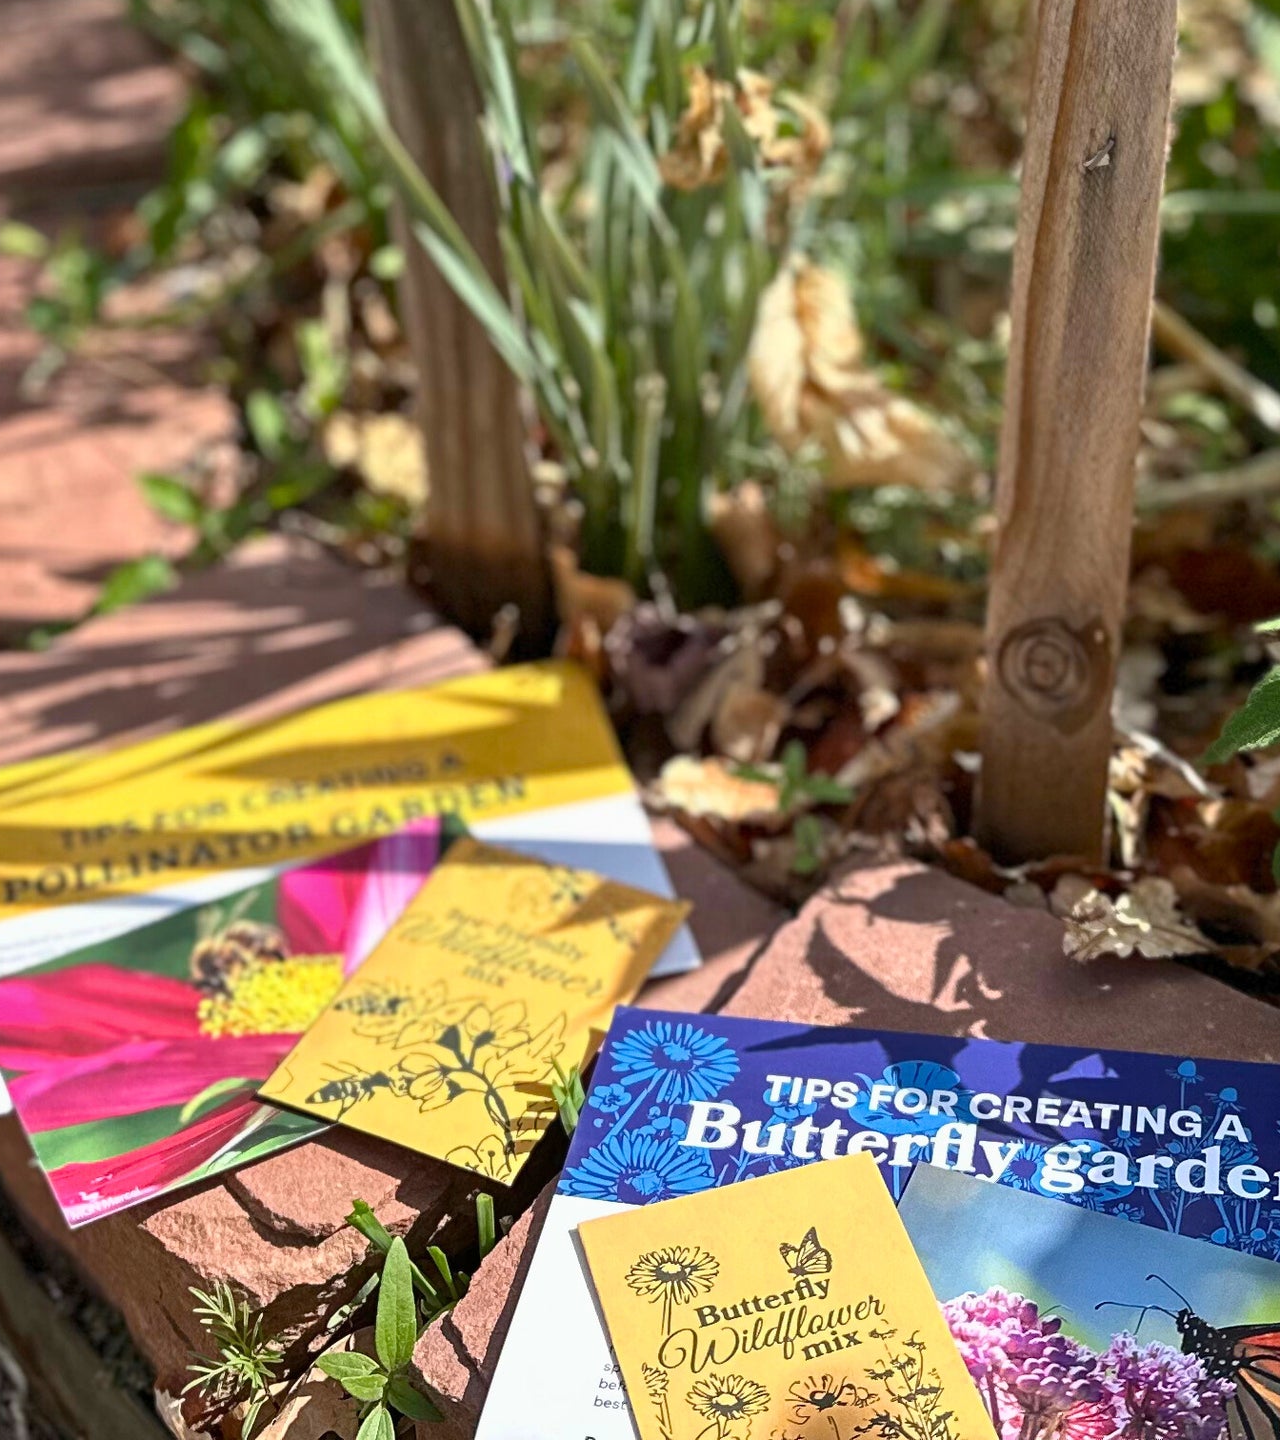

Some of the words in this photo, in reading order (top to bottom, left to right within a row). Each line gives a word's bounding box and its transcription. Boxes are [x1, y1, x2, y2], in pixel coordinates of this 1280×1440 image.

[1, 824, 316, 904] POLLINATOR
[330, 774, 527, 836] GARDEN
[59, 816, 141, 851] TIPS
[154, 798, 229, 831] FOR
[677, 1099, 1023, 1184] Butterfly
[766, 1074, 858, 1110] TIPS
[870, 1082, 958, 1117] FOR
[969, 1092, 1203, 1139] CREATING
[1214, 1114, 1249, 1143] A
[657, 1294, 886, 1374] Wildflower
[693, 1276, 831, 1328] Butterfly
[801, 1329, 863, 1362] mix
